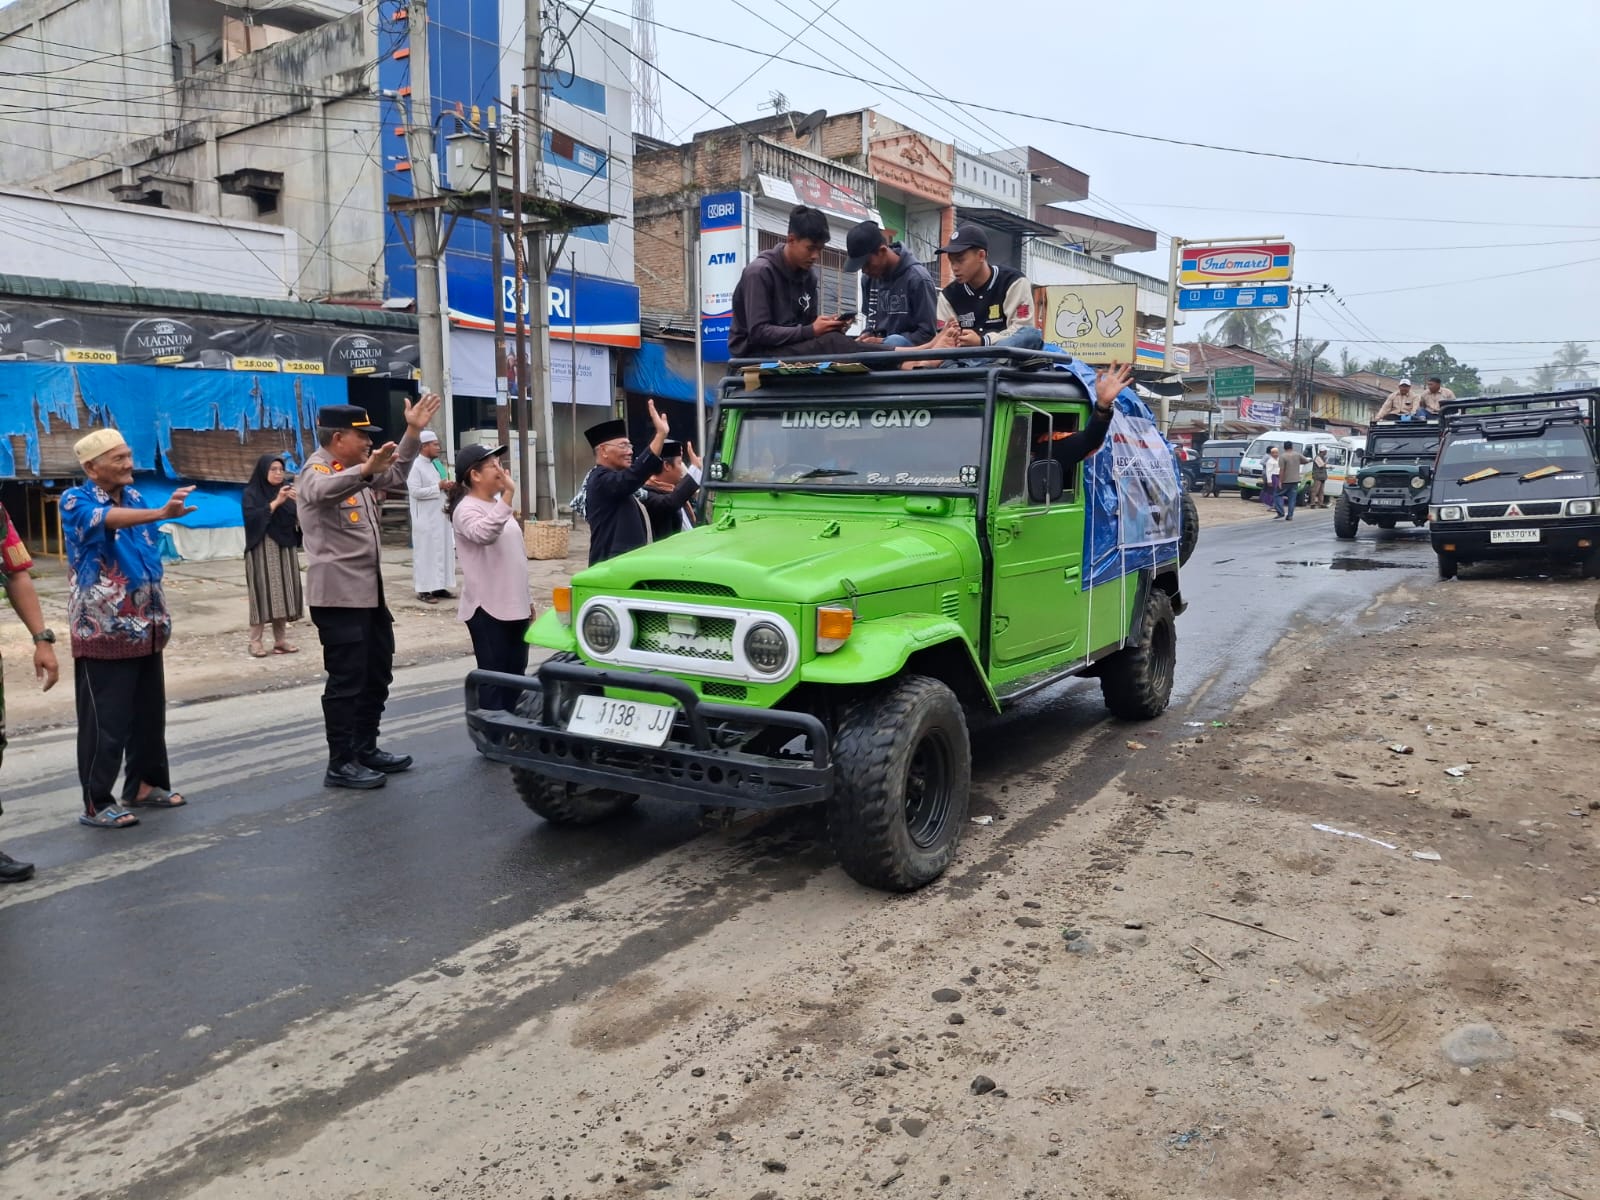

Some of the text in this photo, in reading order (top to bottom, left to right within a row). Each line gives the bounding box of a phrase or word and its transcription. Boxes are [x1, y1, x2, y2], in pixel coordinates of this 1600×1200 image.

[707, 252, 736, 266] ATM
[1202, 256, 1268, 271] Indomaret
[137, 334, 193, 348] MAGNUM
[151, 346, 186, 357] FILTER
[339, 348, 383, 361] MAGNUM
[350, 359, 378, 369] FILTER
[780, 409, 932, 429] LINGGA GAYO
[866, 472, 891, 485] Bre
[576, 698, 672, 732] L 1138 JJ
